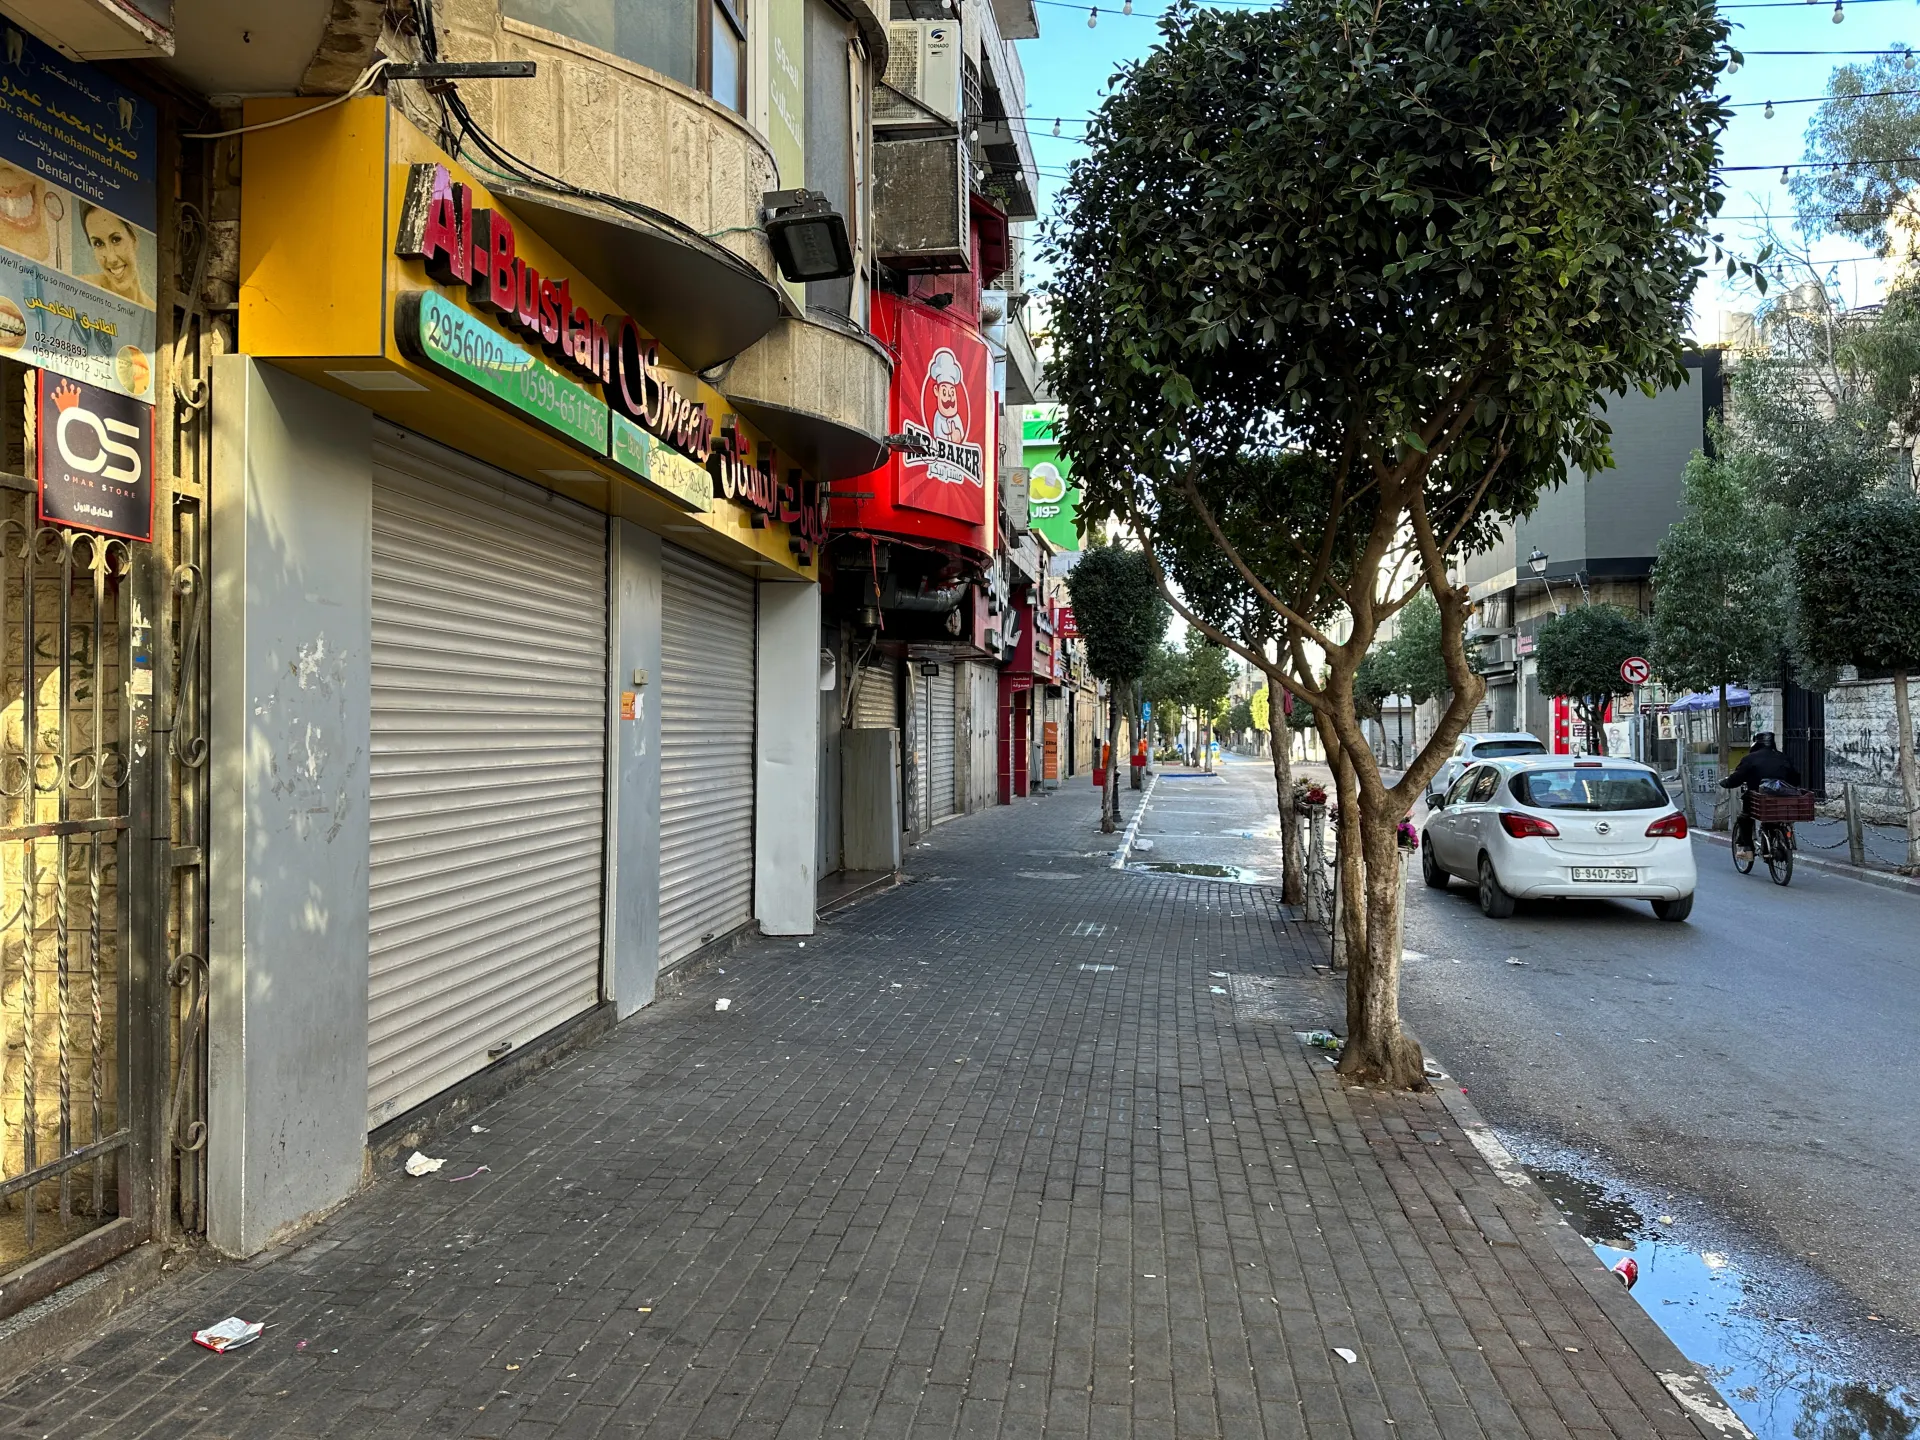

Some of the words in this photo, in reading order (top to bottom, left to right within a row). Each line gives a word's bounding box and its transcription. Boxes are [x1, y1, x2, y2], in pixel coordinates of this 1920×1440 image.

[40, 62, 79, 89] الدكتور
[0, 75, 43, 106] عمرو
[77, 83, 102, 103] عيادة
[46, 100, 91, 135] محمد
[16, 107, 53, 135] Safwat
[54, 127, 113, 167] Mohammad
[114, 160, 140, 182] Amro
[92, 122, 138, 161] صفوت
[36, 156, 72, 185] Dental
[74, 177, 105, 201] Clinic
[67, 154, 99, 179] جراحة
[0, 255, 18, 270] We'll
[18, 264, 35, 277] give
[34, 270, 49, 284] you
[58, 281, 79, 296] many
[79, 290, 104, 305] reasons
[117, 304, 136, 317] Smile!
[422, 162, 610, 385] Al-Bustan
[24, 296, 77, 321] الخامس
[80, 312, 118, 338] الطابق
[32, 345, 90, 373] 0597-127012
[34, 331, 88, 358] 02-2988893
[428, 306, 503, 385] 2956022
[519, 362, 606, 443] 0599-651756
[57, 407, 142, 484] OS
[937, 441, 980, 480] BAKER
[64, 474, 94, 488] OMAR
[102, 484, 136, 499] STORE
[91, 506, 113, 518] الطابق
[1031, 505, 1061, 518] جوال
